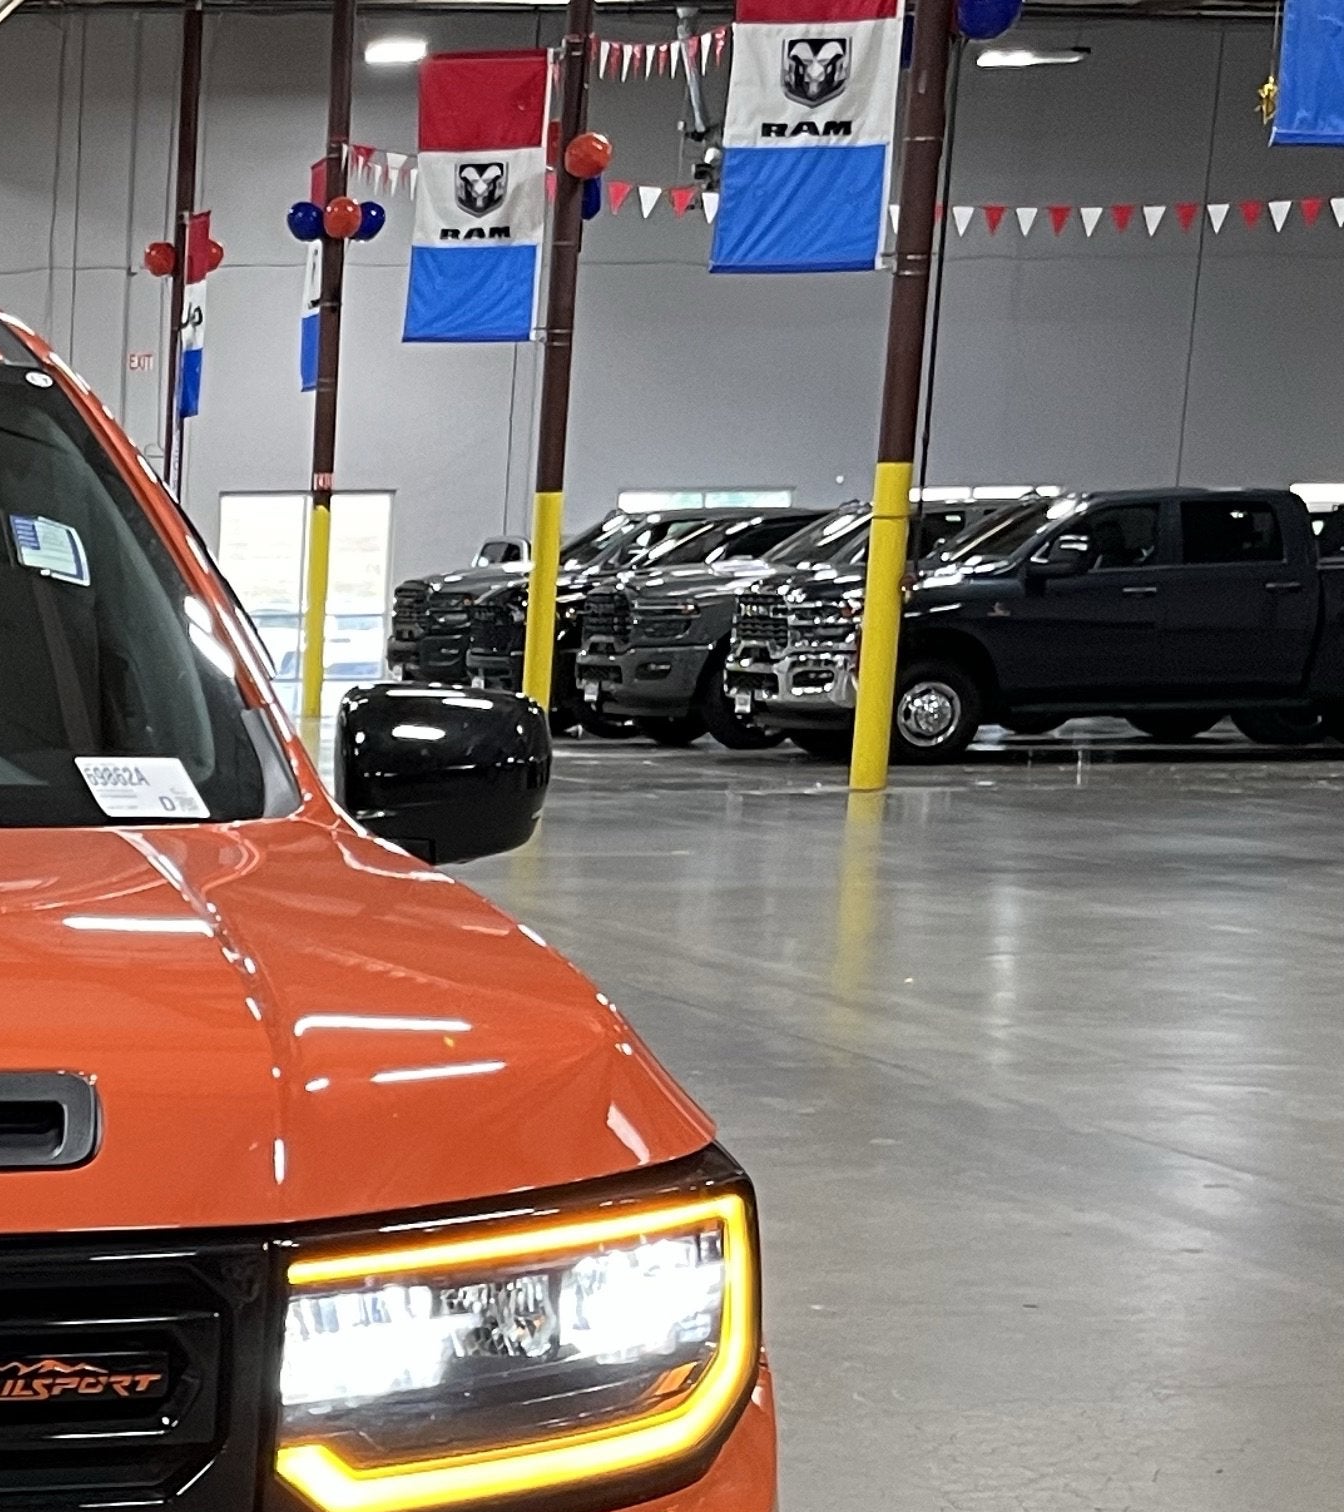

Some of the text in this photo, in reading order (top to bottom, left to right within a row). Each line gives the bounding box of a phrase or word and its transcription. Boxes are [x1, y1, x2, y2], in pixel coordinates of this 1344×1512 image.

[760, 121, 852, 137] RAM
[439, 226, 511, 240] RAM
[129, 353, 153, 370] EXIT
